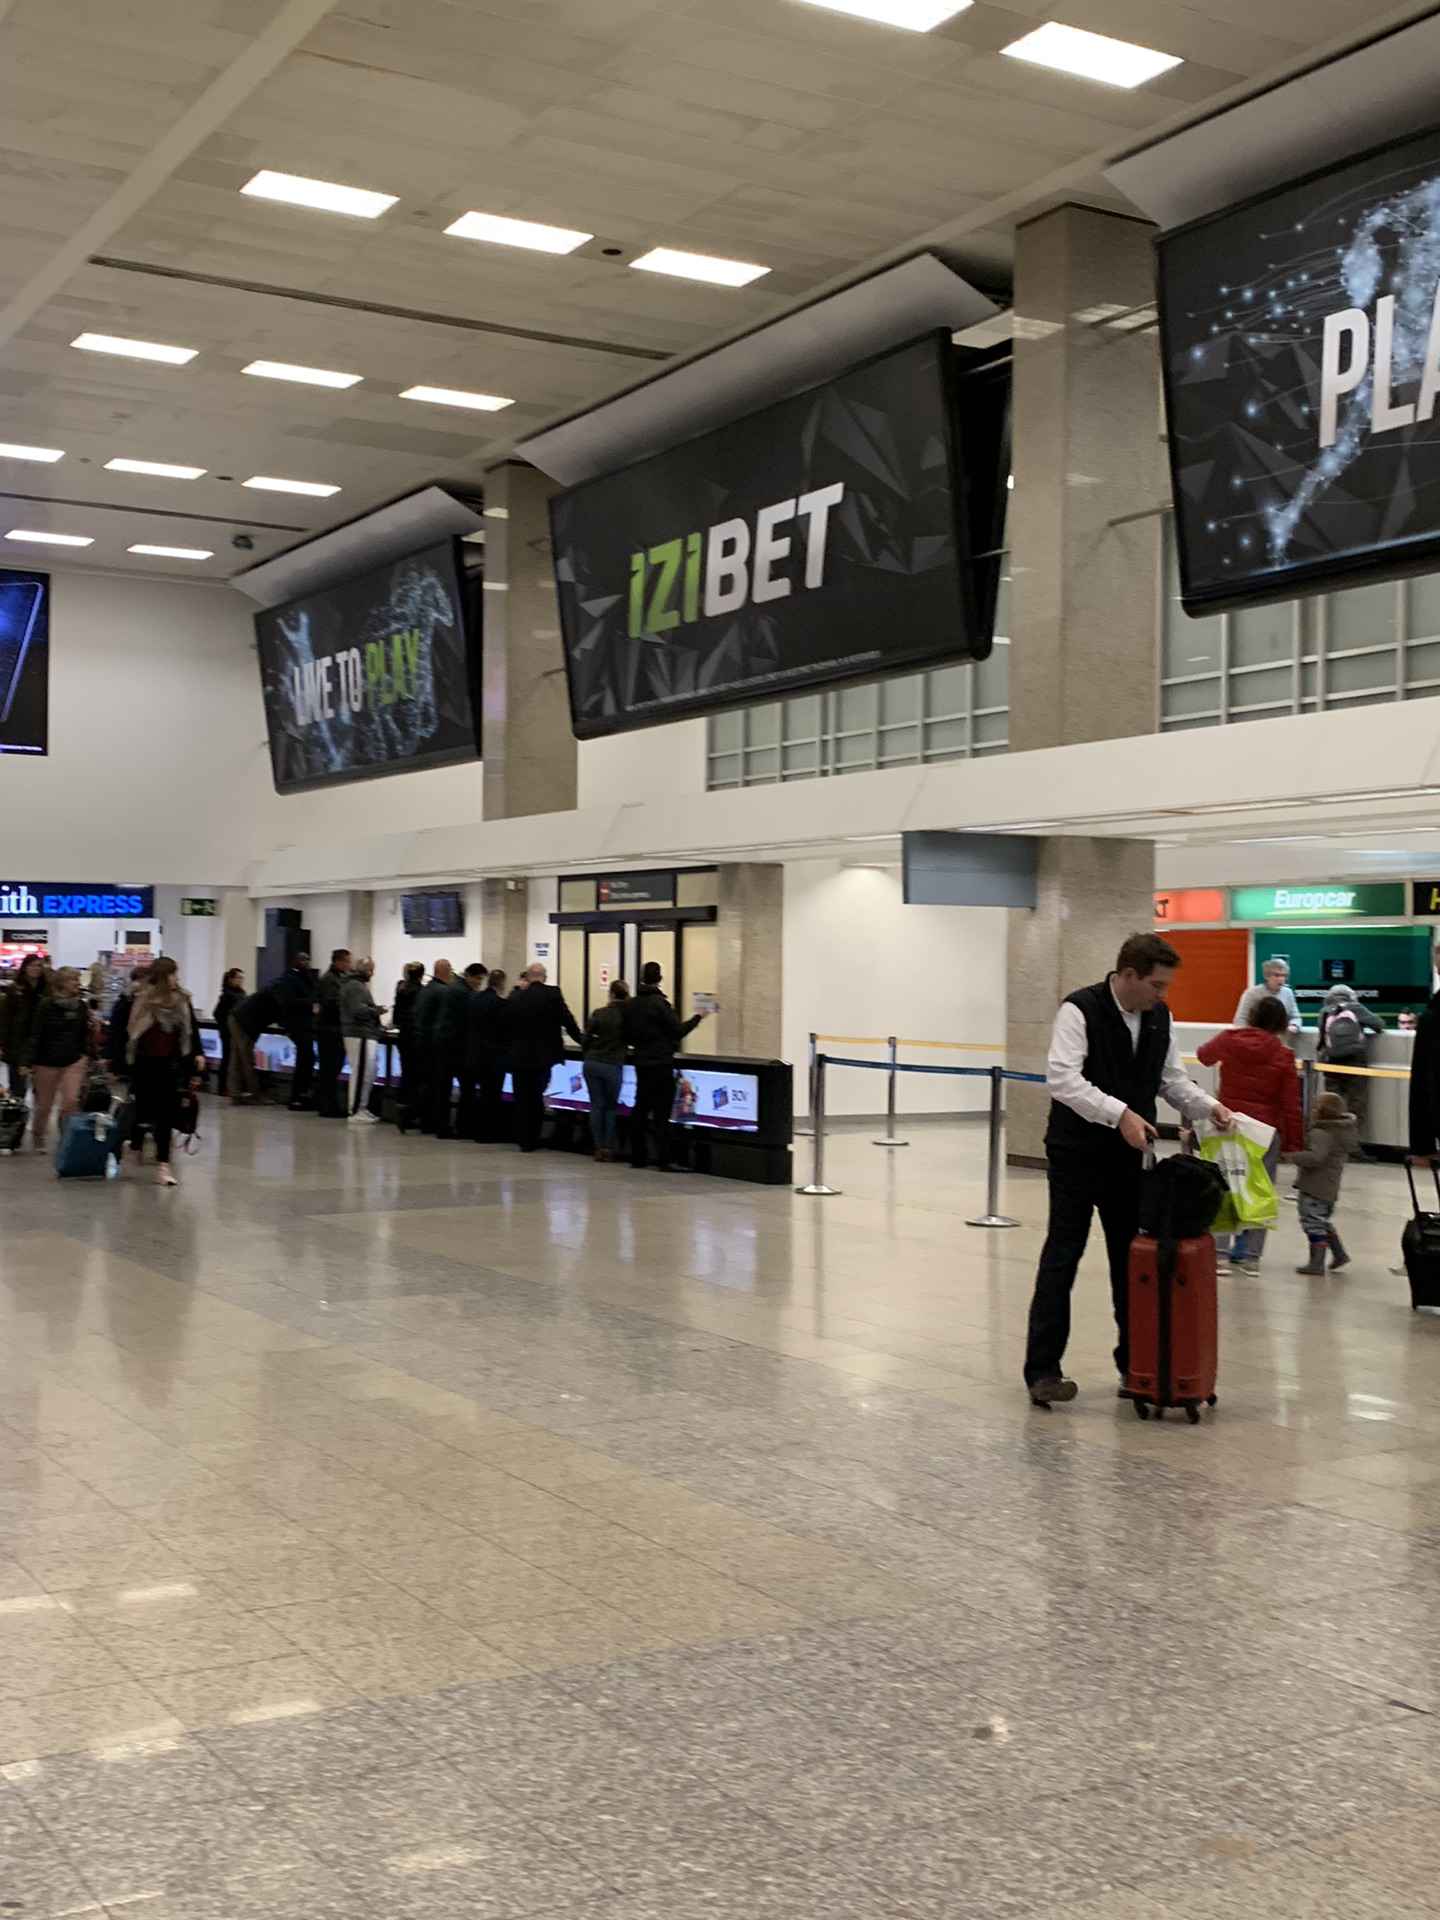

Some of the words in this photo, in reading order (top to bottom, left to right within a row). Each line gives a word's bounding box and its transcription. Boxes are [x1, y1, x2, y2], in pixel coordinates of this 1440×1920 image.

[293, 656, 335, 726] LIVE
[335, 647, 362, 712] TO
[365, 628, 420, 706] PLAY
[43, 895, 143, 914] EXPRESS
[1274, 889, 1356, 912] Europcar
